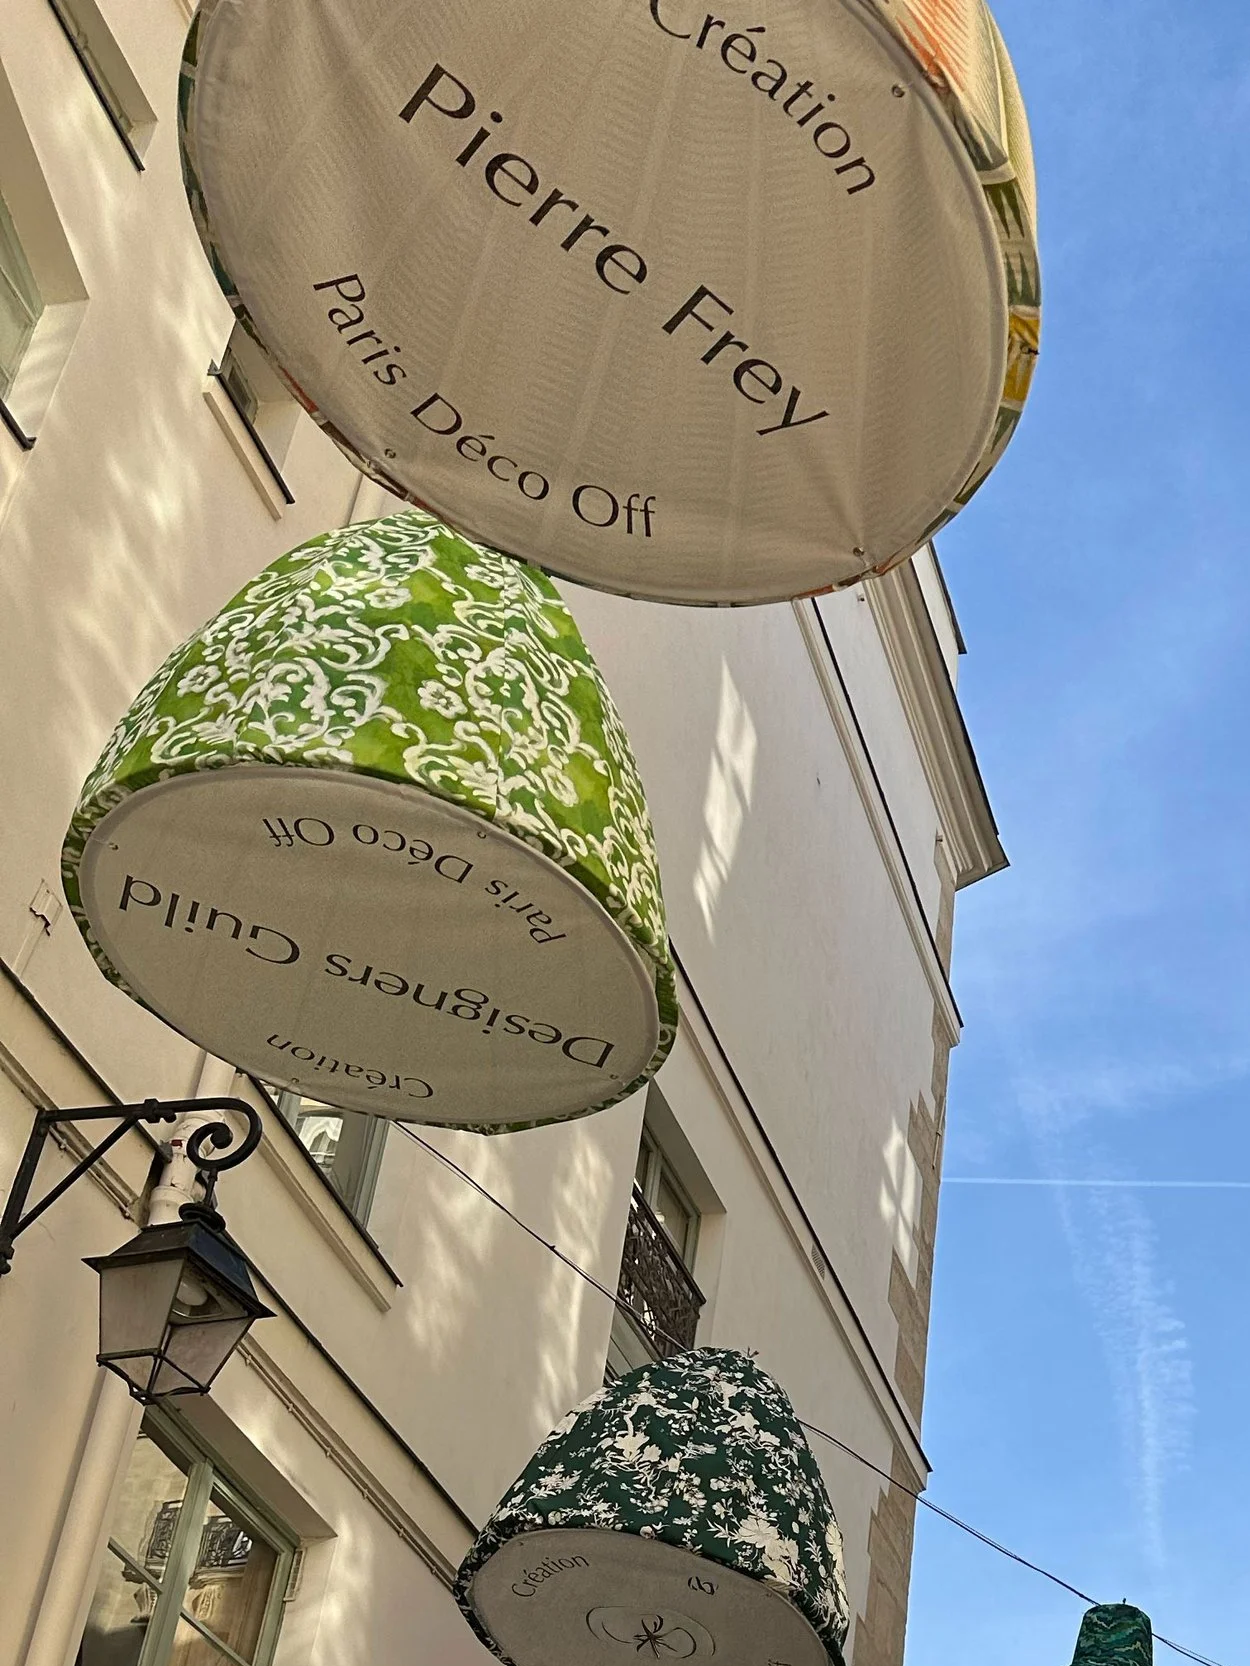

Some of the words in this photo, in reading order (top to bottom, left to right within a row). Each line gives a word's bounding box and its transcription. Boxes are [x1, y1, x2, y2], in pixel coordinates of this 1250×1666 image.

[650, 0, 876, 196] Création
[399, 63, 648, 296] Pierre
[661, 285, 831, 437] Frey
[312, 273, 408, 389] Paris
[410, 392, 550, 501] Déco
[571, 485, 657, 538] Off
[261, 817, 335, 848] Off
[353, 823, 474, 884] Déco
[118, 874, 300, 965] Guild
[484, 880, 567, 946] Paris
[324, 953, 615, 1069] Designers
[266, 1033, 434, 1099] Création
[511, 1554, 590, 1599] Création
